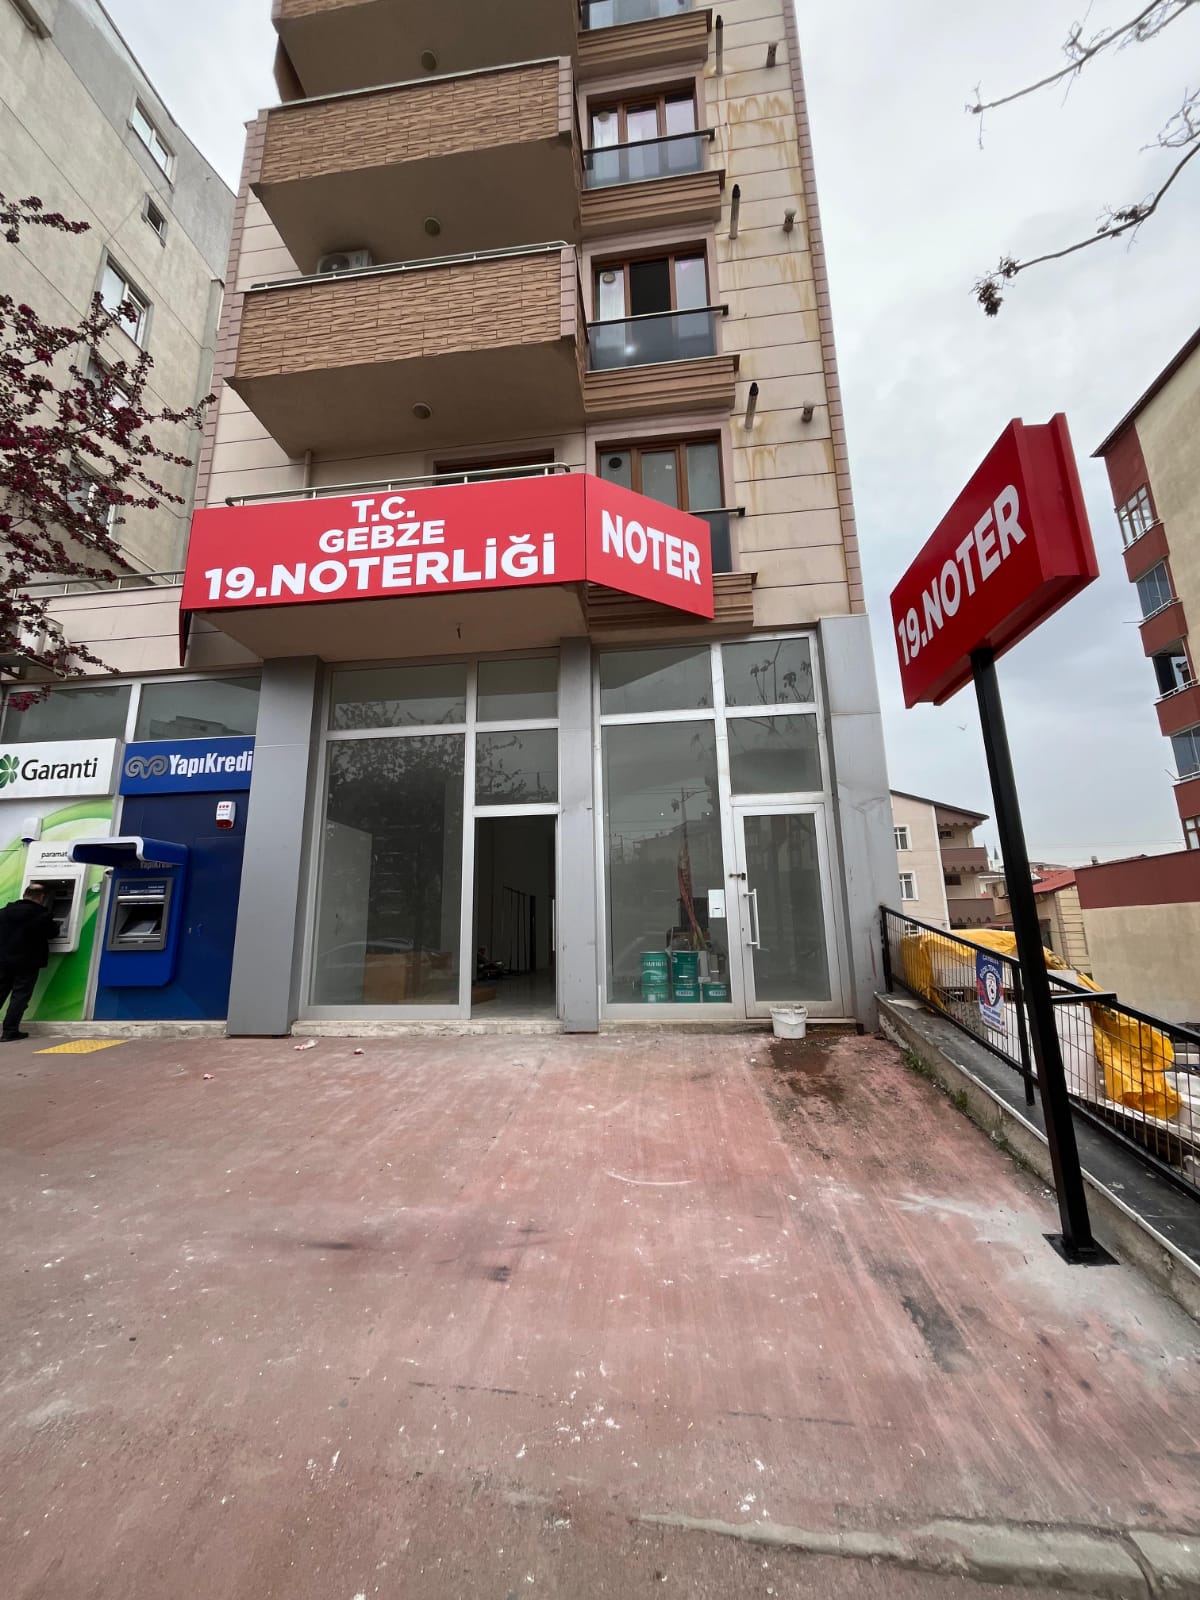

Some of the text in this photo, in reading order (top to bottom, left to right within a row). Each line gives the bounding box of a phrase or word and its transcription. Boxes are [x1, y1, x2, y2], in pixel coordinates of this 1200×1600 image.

[352, 496, 415, 522] T.C.
[319, 520, 445, 553] GEBZE
[602, 510, 701, 585] NOTER
[205, 533, 554, 599] 19.NOTERLİĞİ
[898, 485, 1026, 665] 19.NOTER
[22, 757, 97, 780] Garanti
